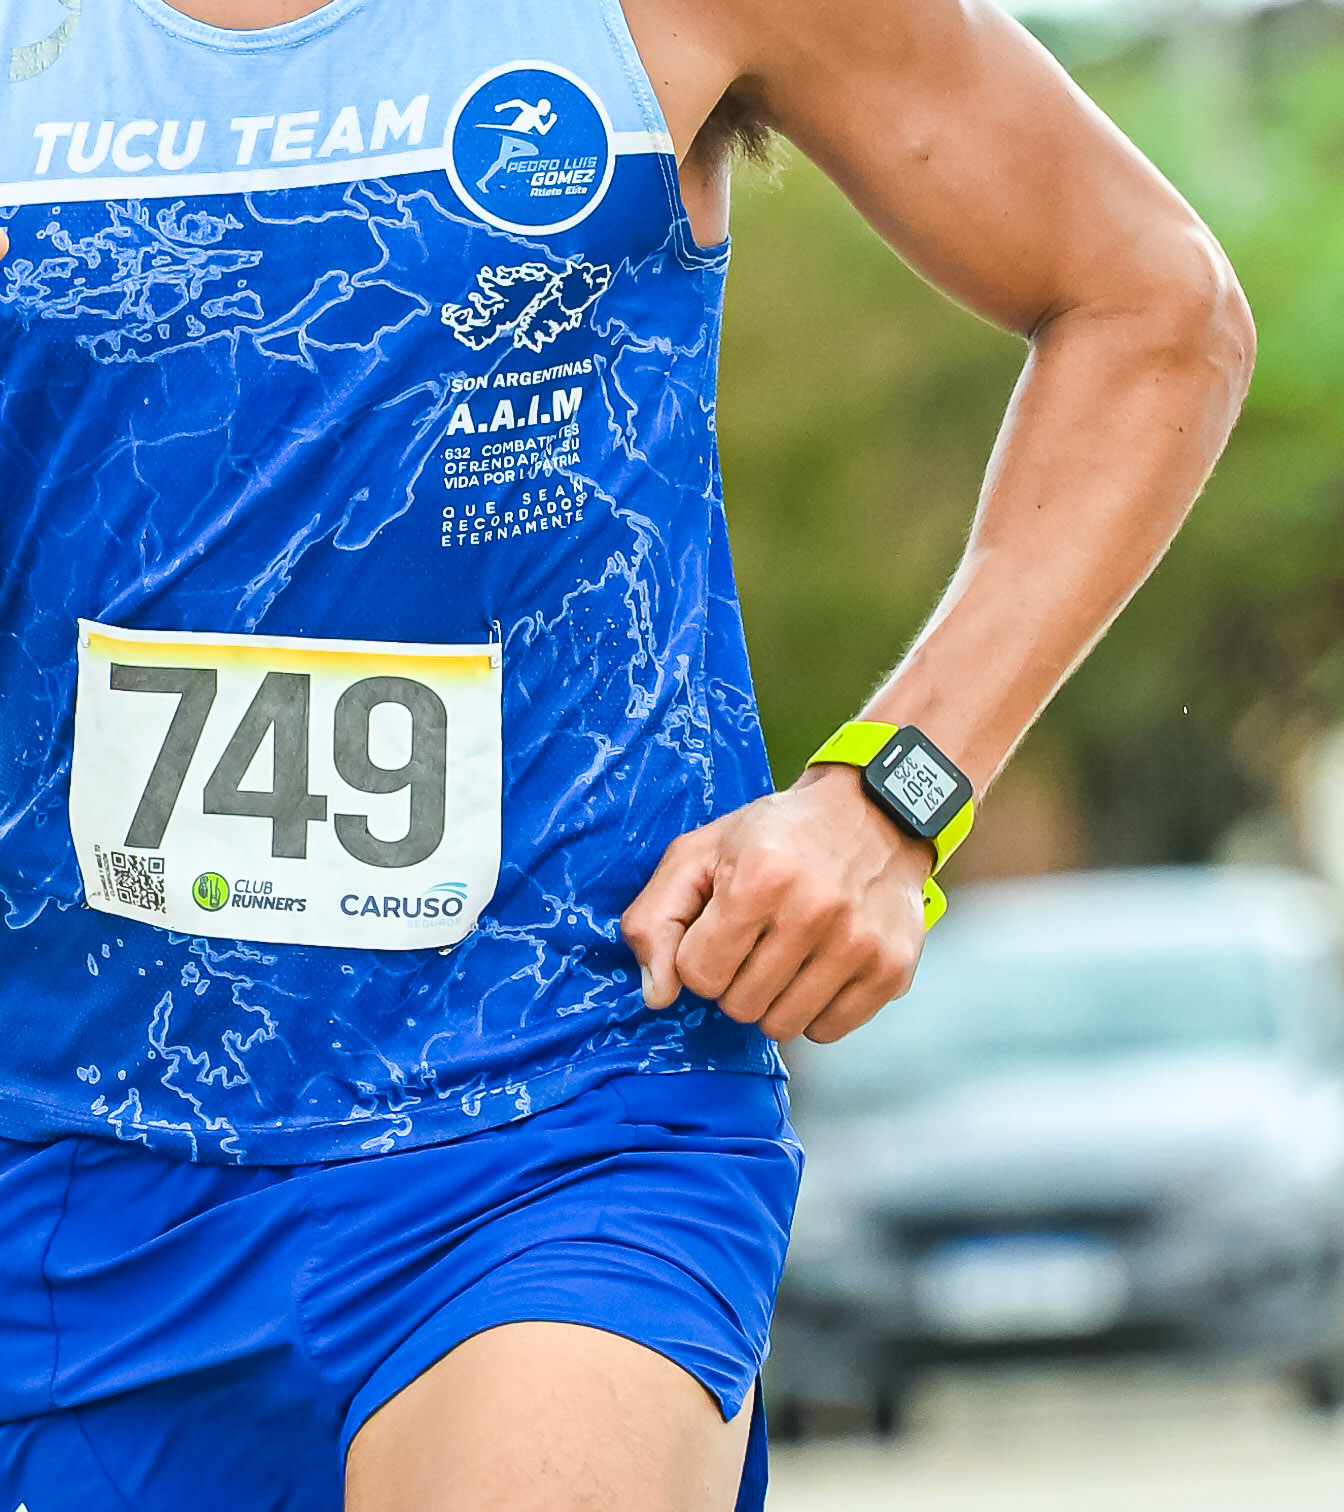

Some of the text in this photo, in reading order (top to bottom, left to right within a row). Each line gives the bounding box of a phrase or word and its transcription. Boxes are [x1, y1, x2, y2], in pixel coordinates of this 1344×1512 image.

[31, 93, 430, 175] TUCU TEAM
[506, 157, 598, 173] PEDRO LUIS
[530, 169, 596, 186] GOMEZ
[450, 358, 593, 393] SON ARGENTINAS
[444, 446, 471, 460] 632
[561, 437, 580, 452] SU
[443, 474, 480, 490] VIDA
[483, 469, 516, 485] POR
[534, 452, 581, 472] PATRIA
[442, 478, 584, 519] QUE SEAN
[442, 494, 585, 533] RECORDADOS
[441, 509, 584, 547] ETERNAMENTE
[110, 662, 448, 868] 749
[902, 764, 938, 807] 15:07
[231, 894, 307, 912] RUNNER'S
[234, 879, 273, 895] CLUB
[340, 894, 463, 918] CARUSO
